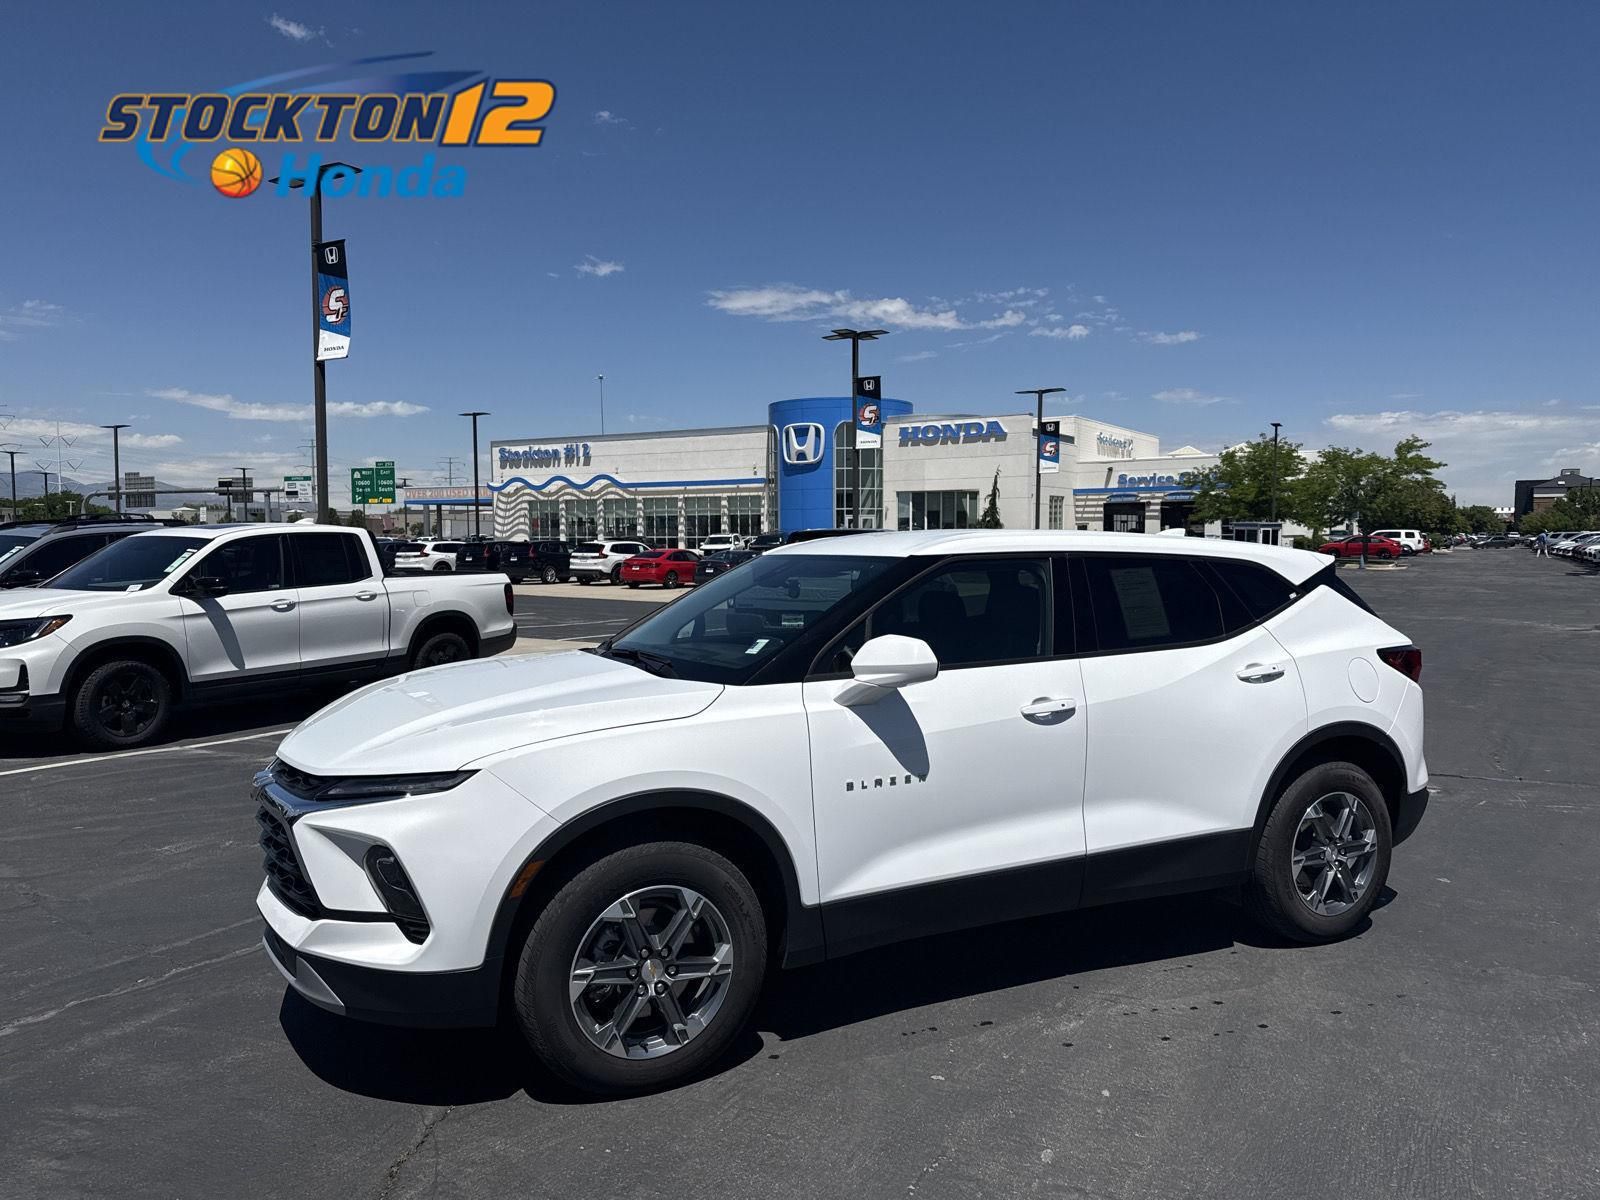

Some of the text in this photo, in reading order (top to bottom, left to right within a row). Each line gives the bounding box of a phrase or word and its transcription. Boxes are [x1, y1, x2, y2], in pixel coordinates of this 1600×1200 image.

[899, 420, 1007, 442] HONDA
[499, 446, 560, 460] Stockton
[1119, 472, 1175, 488] Service
